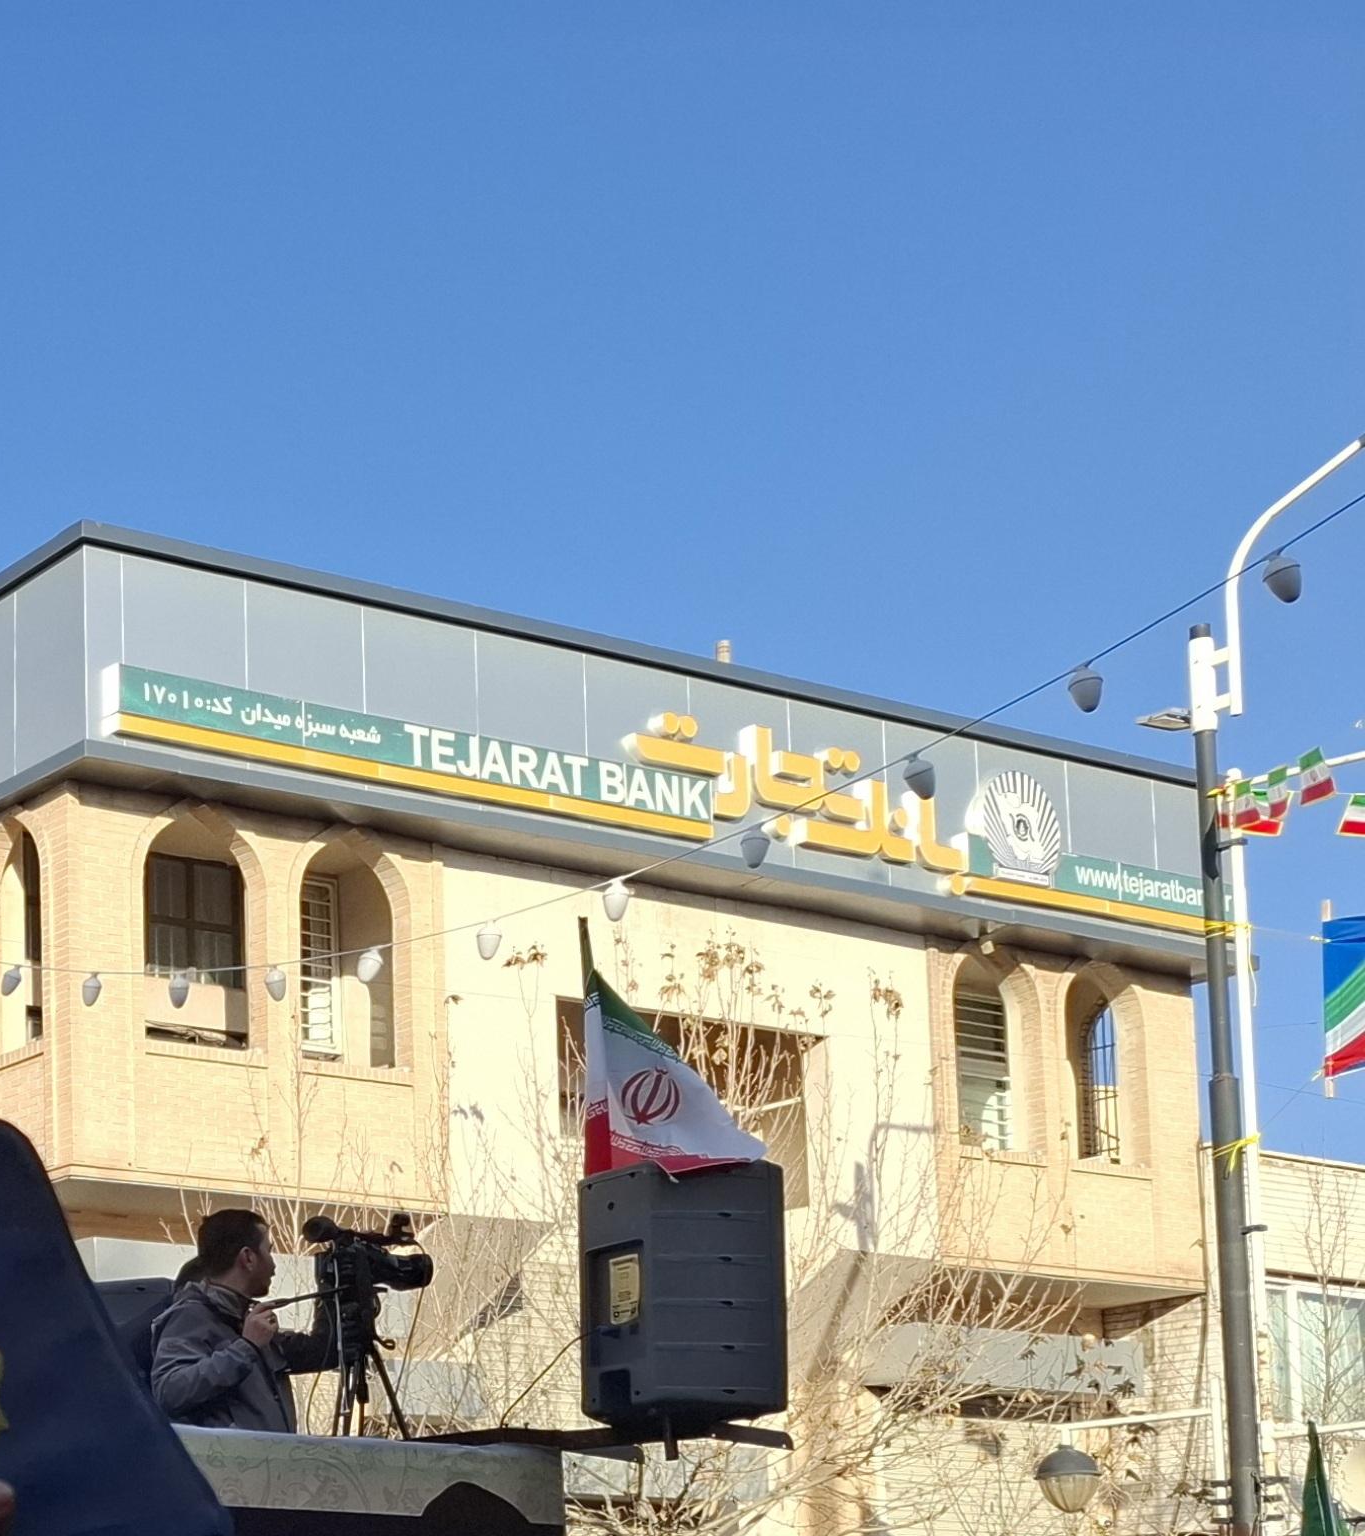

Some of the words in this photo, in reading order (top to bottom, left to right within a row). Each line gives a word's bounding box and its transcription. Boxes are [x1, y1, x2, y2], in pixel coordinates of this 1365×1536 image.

[240, 703, 291, 730] میدان
[294, 714, 336, 737] سبزه
[340, 718, 381, 745] شعبه
[404, 723, 589, 797] TEJARAT
[599, 761, 709, 820] BANK
[623, 711, 869, 840] تجارت
